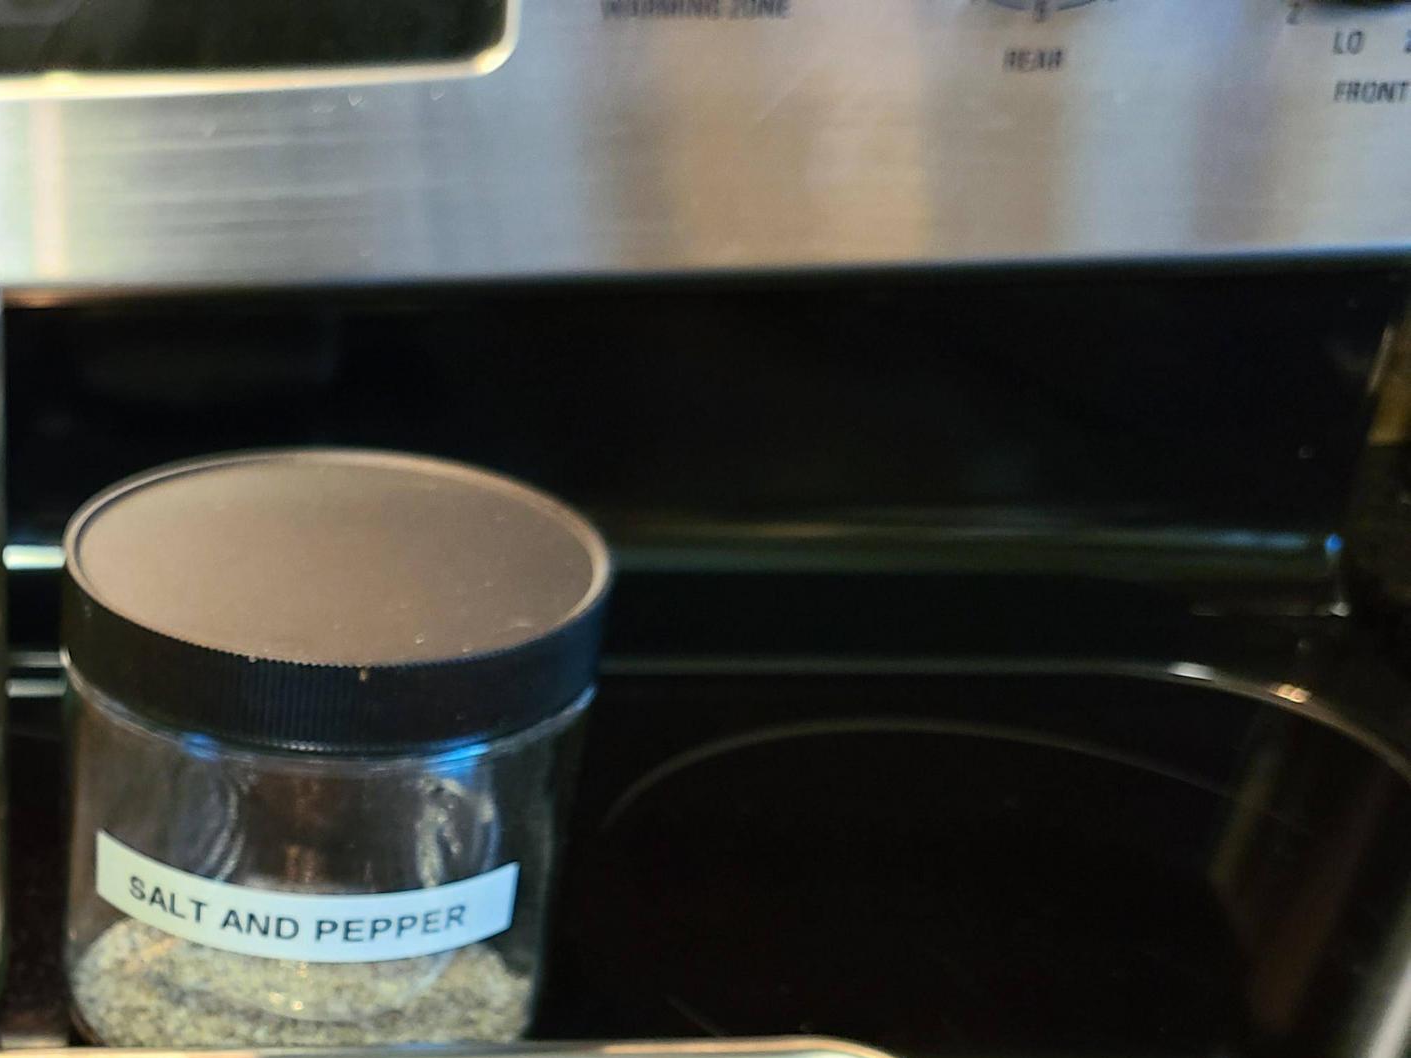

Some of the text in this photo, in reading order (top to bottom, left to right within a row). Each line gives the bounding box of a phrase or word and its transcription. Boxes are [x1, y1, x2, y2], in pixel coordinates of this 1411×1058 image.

[1332, 30, 1365, 55] LO
[1003, 48, 1063, 72] REAR
[1334, 81, 1410, 103] FRONT
[129, 874, 467, 943] SALT AND PEPPER
